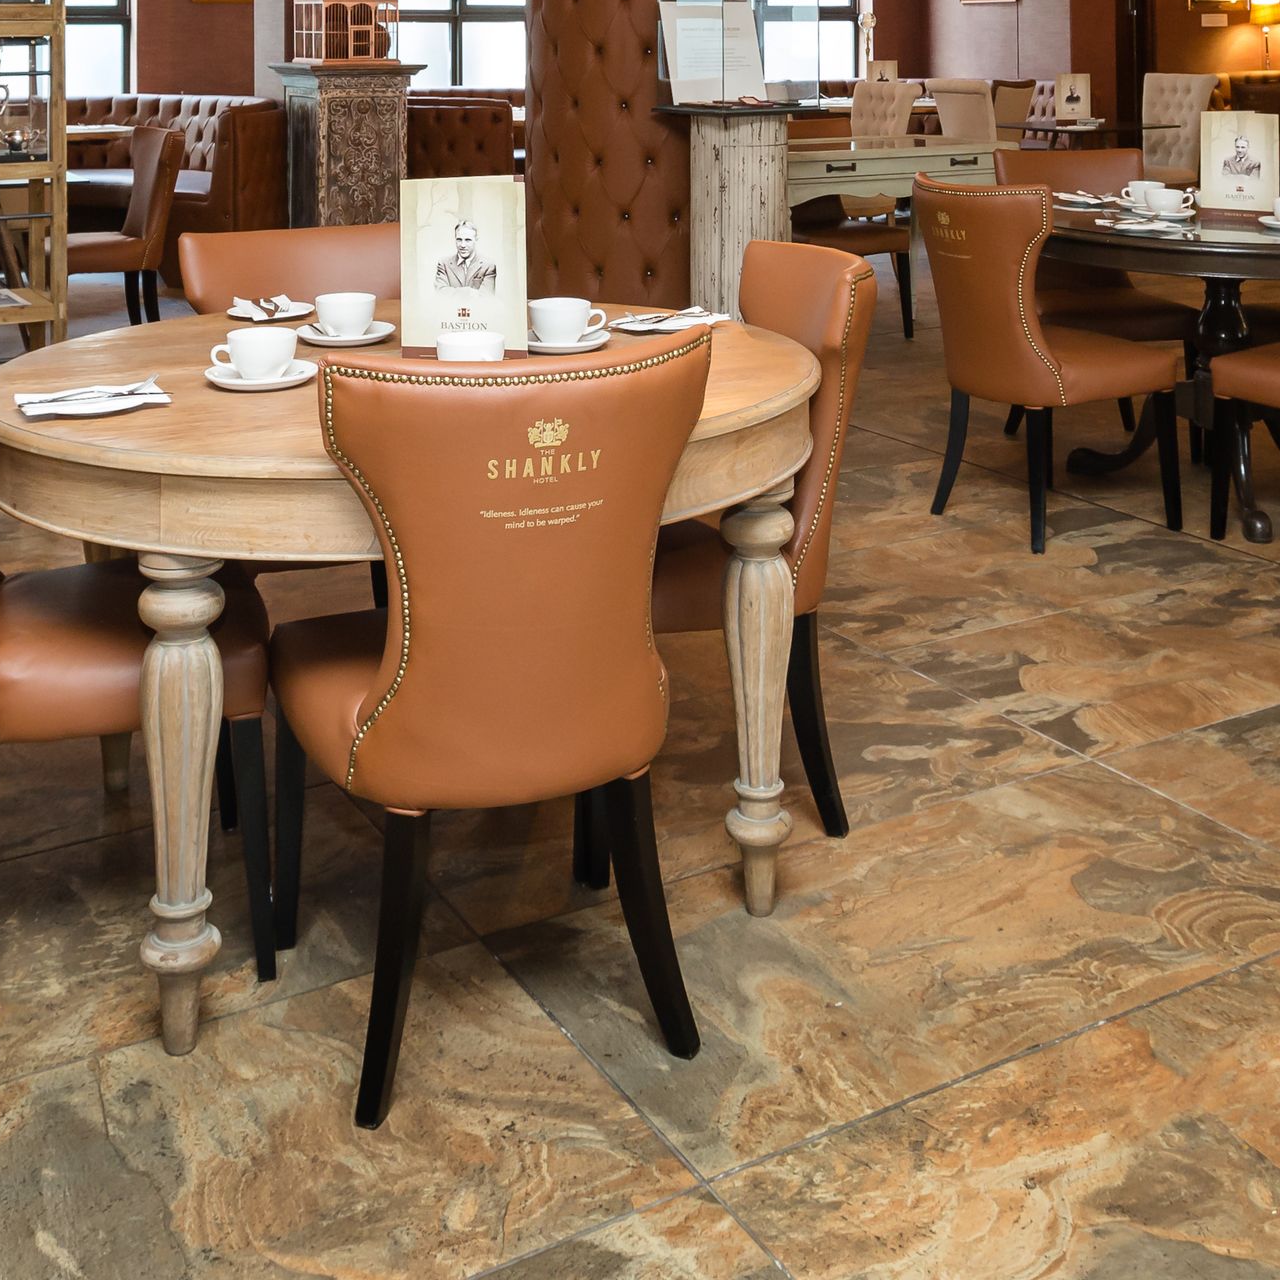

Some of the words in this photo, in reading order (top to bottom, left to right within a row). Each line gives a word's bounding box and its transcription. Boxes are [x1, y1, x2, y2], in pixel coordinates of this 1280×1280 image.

[441, 321, 488, 331] BASTION
[540, 448, 556, 456] THE
[487, 449, 602, 480] SHANKLY
[533, 476, 559, 485] HOTEL
[519, 506, 549, 517] Idleness
[550, 506, 565, 514] can
[566, 503, 587, 511] cause
[587, 499, 604, 510] your
[505, 520, 525, 530] mind
[526, 519, 535, 528] to
[536, 518, 546, 527] be
